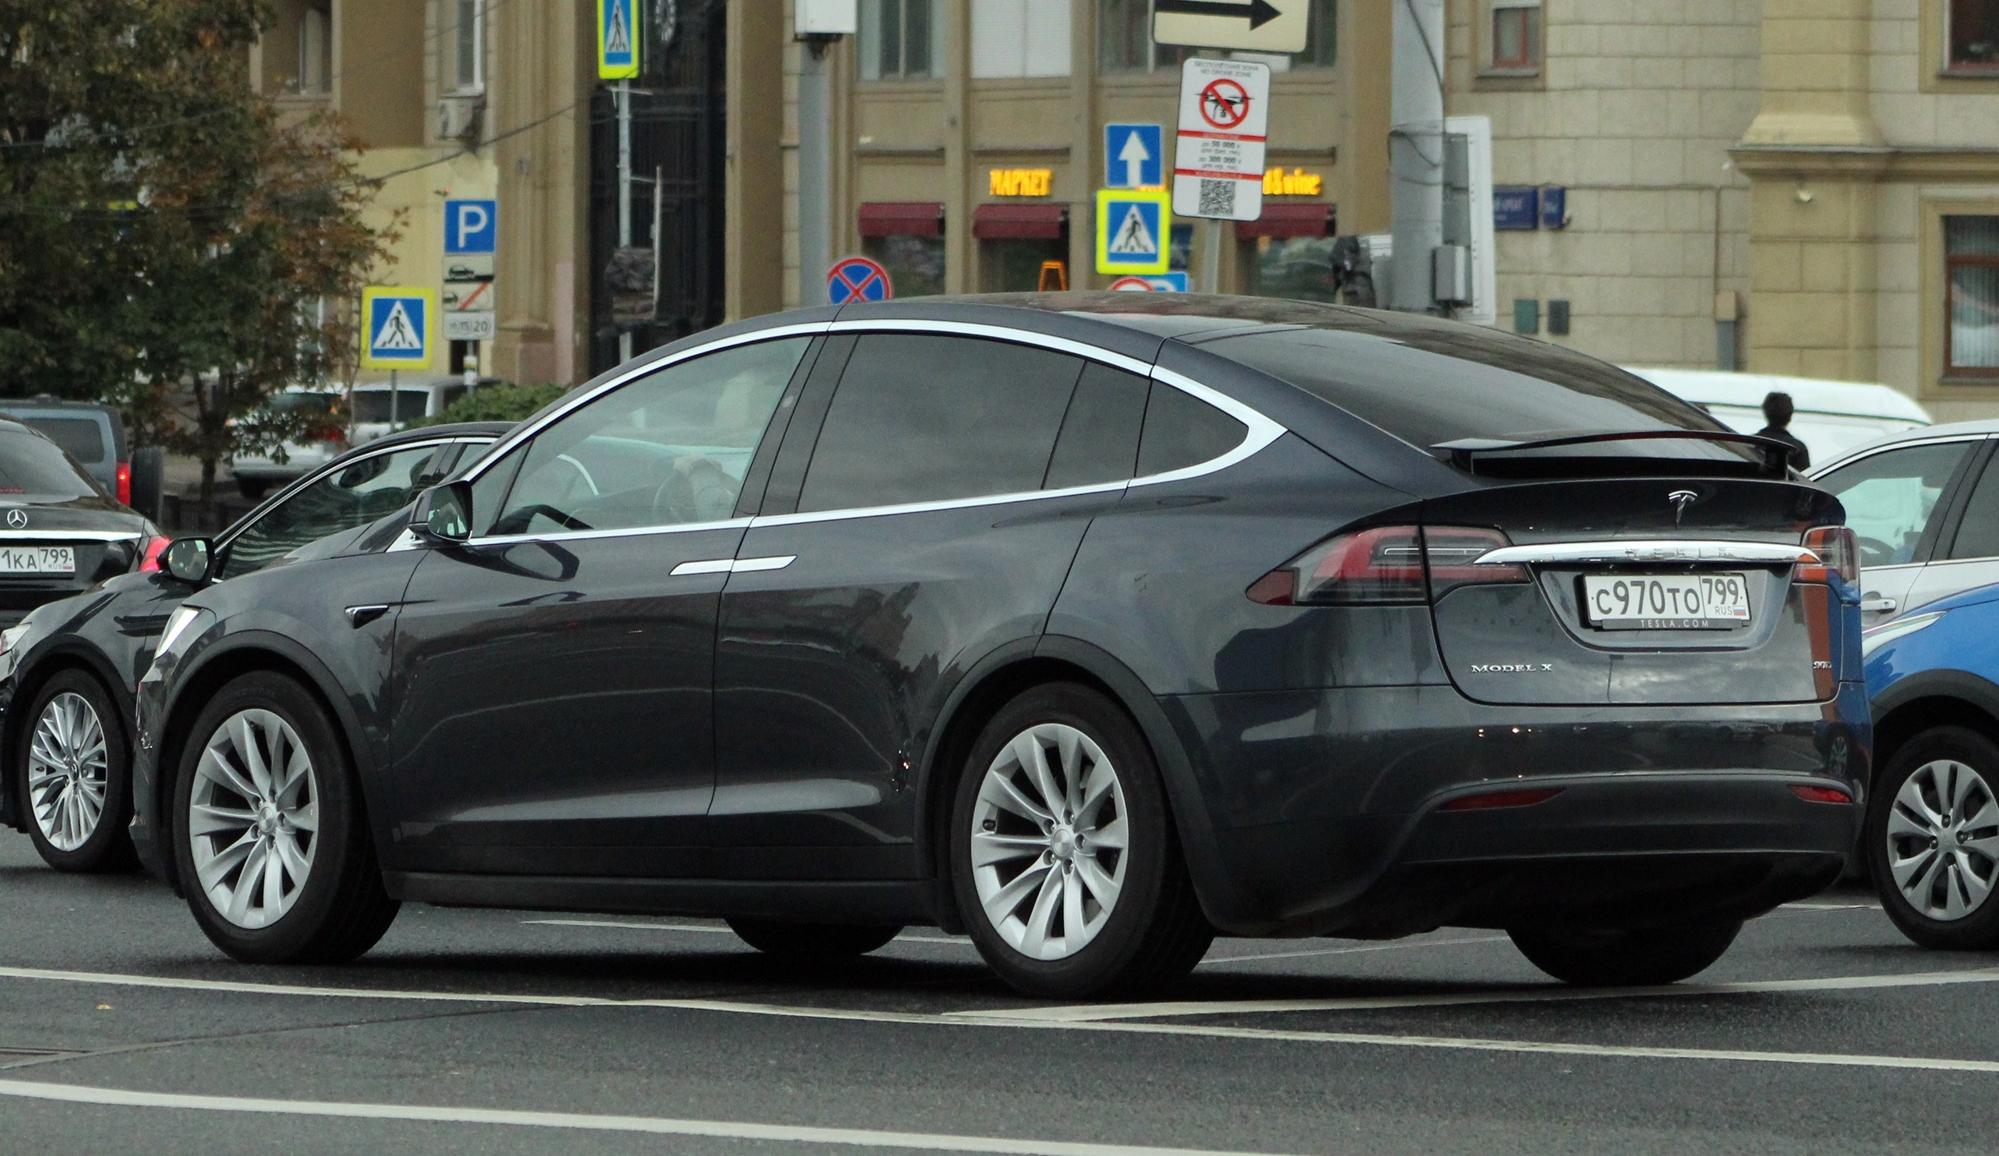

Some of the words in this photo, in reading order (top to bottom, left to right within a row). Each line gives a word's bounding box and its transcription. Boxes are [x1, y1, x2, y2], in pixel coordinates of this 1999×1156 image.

[458, 205, 488, 248] P
[41, 548, 69, 564] 799
[1702, 578, 1739, 605] 799
[1715, 606, 1733, 615] RUS
[1640, 619, 1709, 628] TESLA.COM
[1471, 664, 1537, 673] MODEL
[1541, 663, 1553, 671] X
